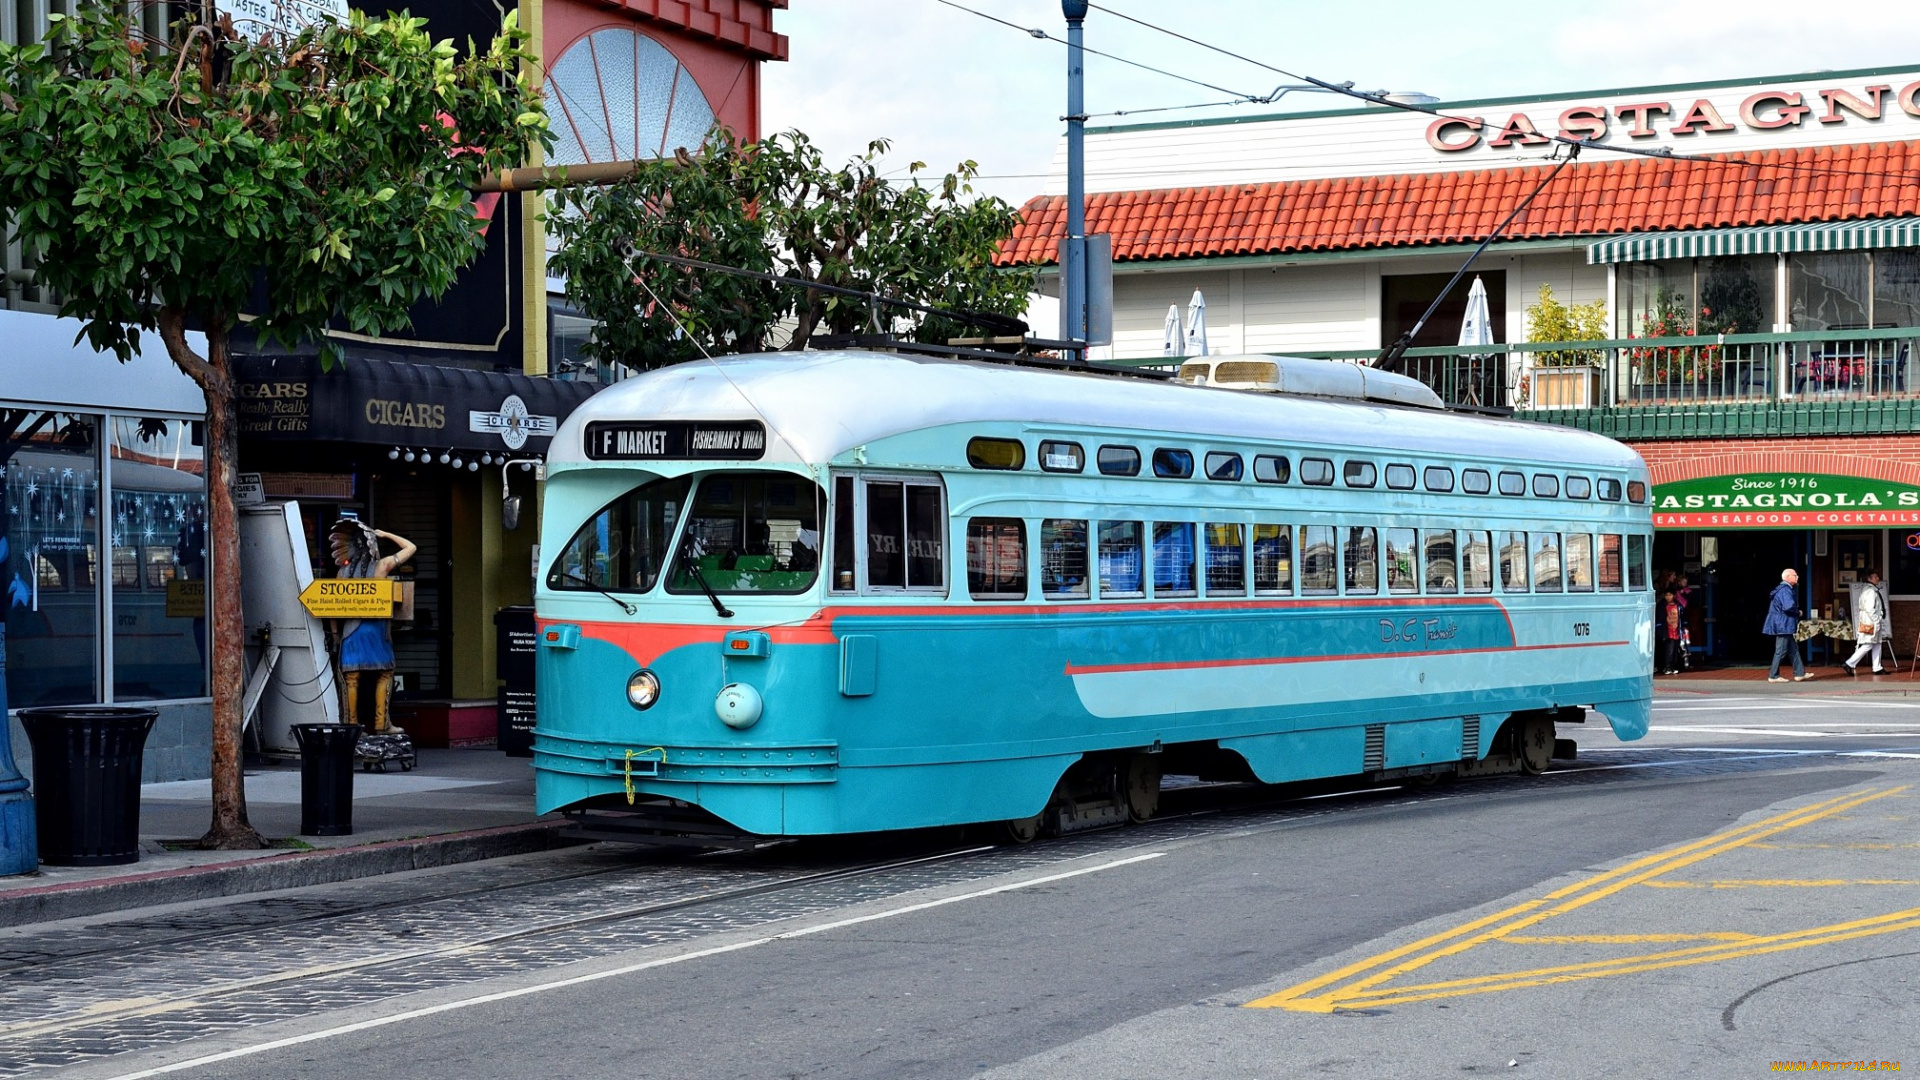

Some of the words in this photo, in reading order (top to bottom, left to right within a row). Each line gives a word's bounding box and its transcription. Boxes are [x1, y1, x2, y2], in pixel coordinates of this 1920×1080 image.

[273, 399, 309, 416] Really
[365, 398, 446, 430] CIGARS
[239, 418, 273, 432] Great
[277, 417, 308, 432] Gifts
[603, 431, 612, 454] F
[617, 431, 667, 454] MARKET
[692, 430, 741, 450] FISHERMAN'S
[742, 430, 763, 450] WHAR
[1731, 477, 1776, 491] Since
[1779, 477, 1818, 489] 1916
[1657, 515, 1688, 524] EAK
[1711, 515, 1792, 524] SEAFOOD
[1816, 513, 1919, 523] COCKTAILS
[320, 582, 377, 595] STOGIES
[1379, 618, 1417, 642] D.C.
[1421, 617, 1458, 649] Transit
[1573, 623, 1590, 637] 1076
